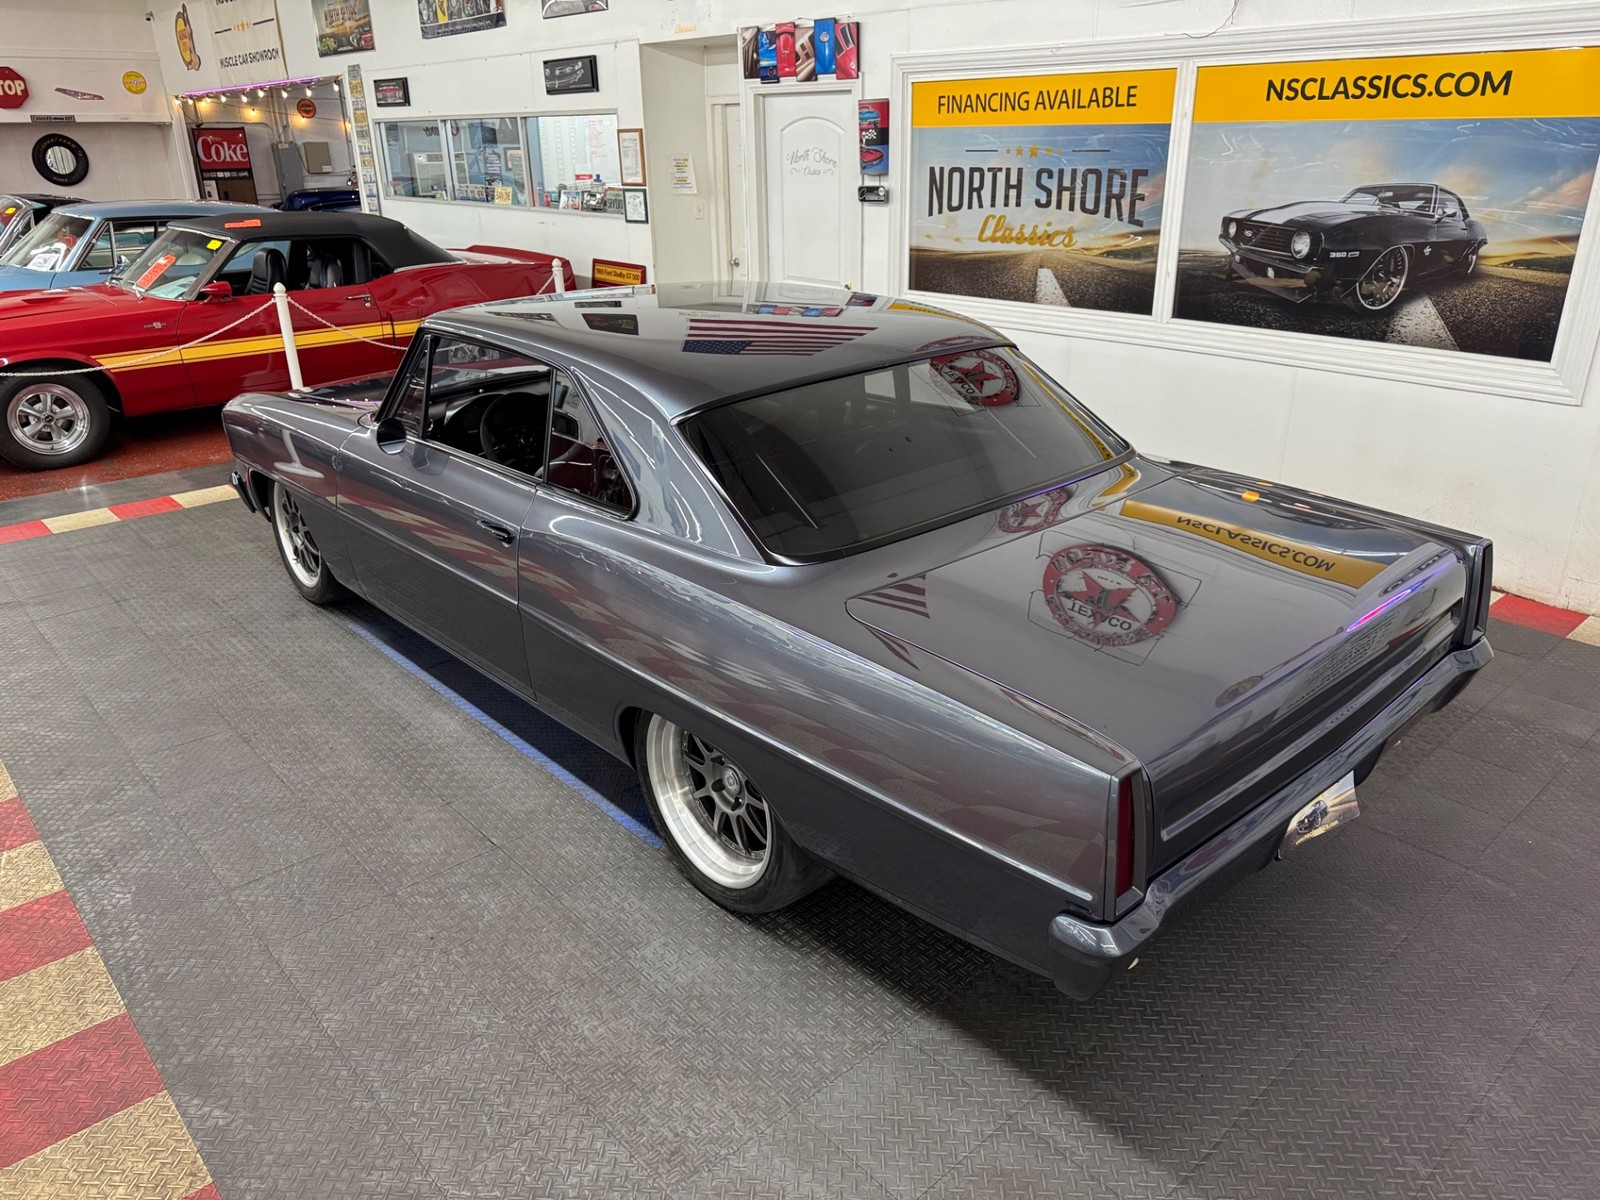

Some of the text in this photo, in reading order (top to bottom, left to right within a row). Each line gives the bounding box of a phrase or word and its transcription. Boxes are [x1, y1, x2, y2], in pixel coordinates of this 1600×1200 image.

[220, 48, 280, 69] MUSCLE CAR SHOWROOM
[0, 80, 25, 96] TOP
[937, 85, 1138, 114] FINANCING AVAILABLE
[1265, 70, 1513, 102] NSCLASSICS.COM
[197, 136, 249, 163] Coke
[786, 147, 838, 168] North Shore
[928, 166, 1149, 228] NORTH SHORE
[977, 213, 1078, 248] Classics
[604, 269, 613, 277] Ford
[613, 270, 625, 280] Shelby
